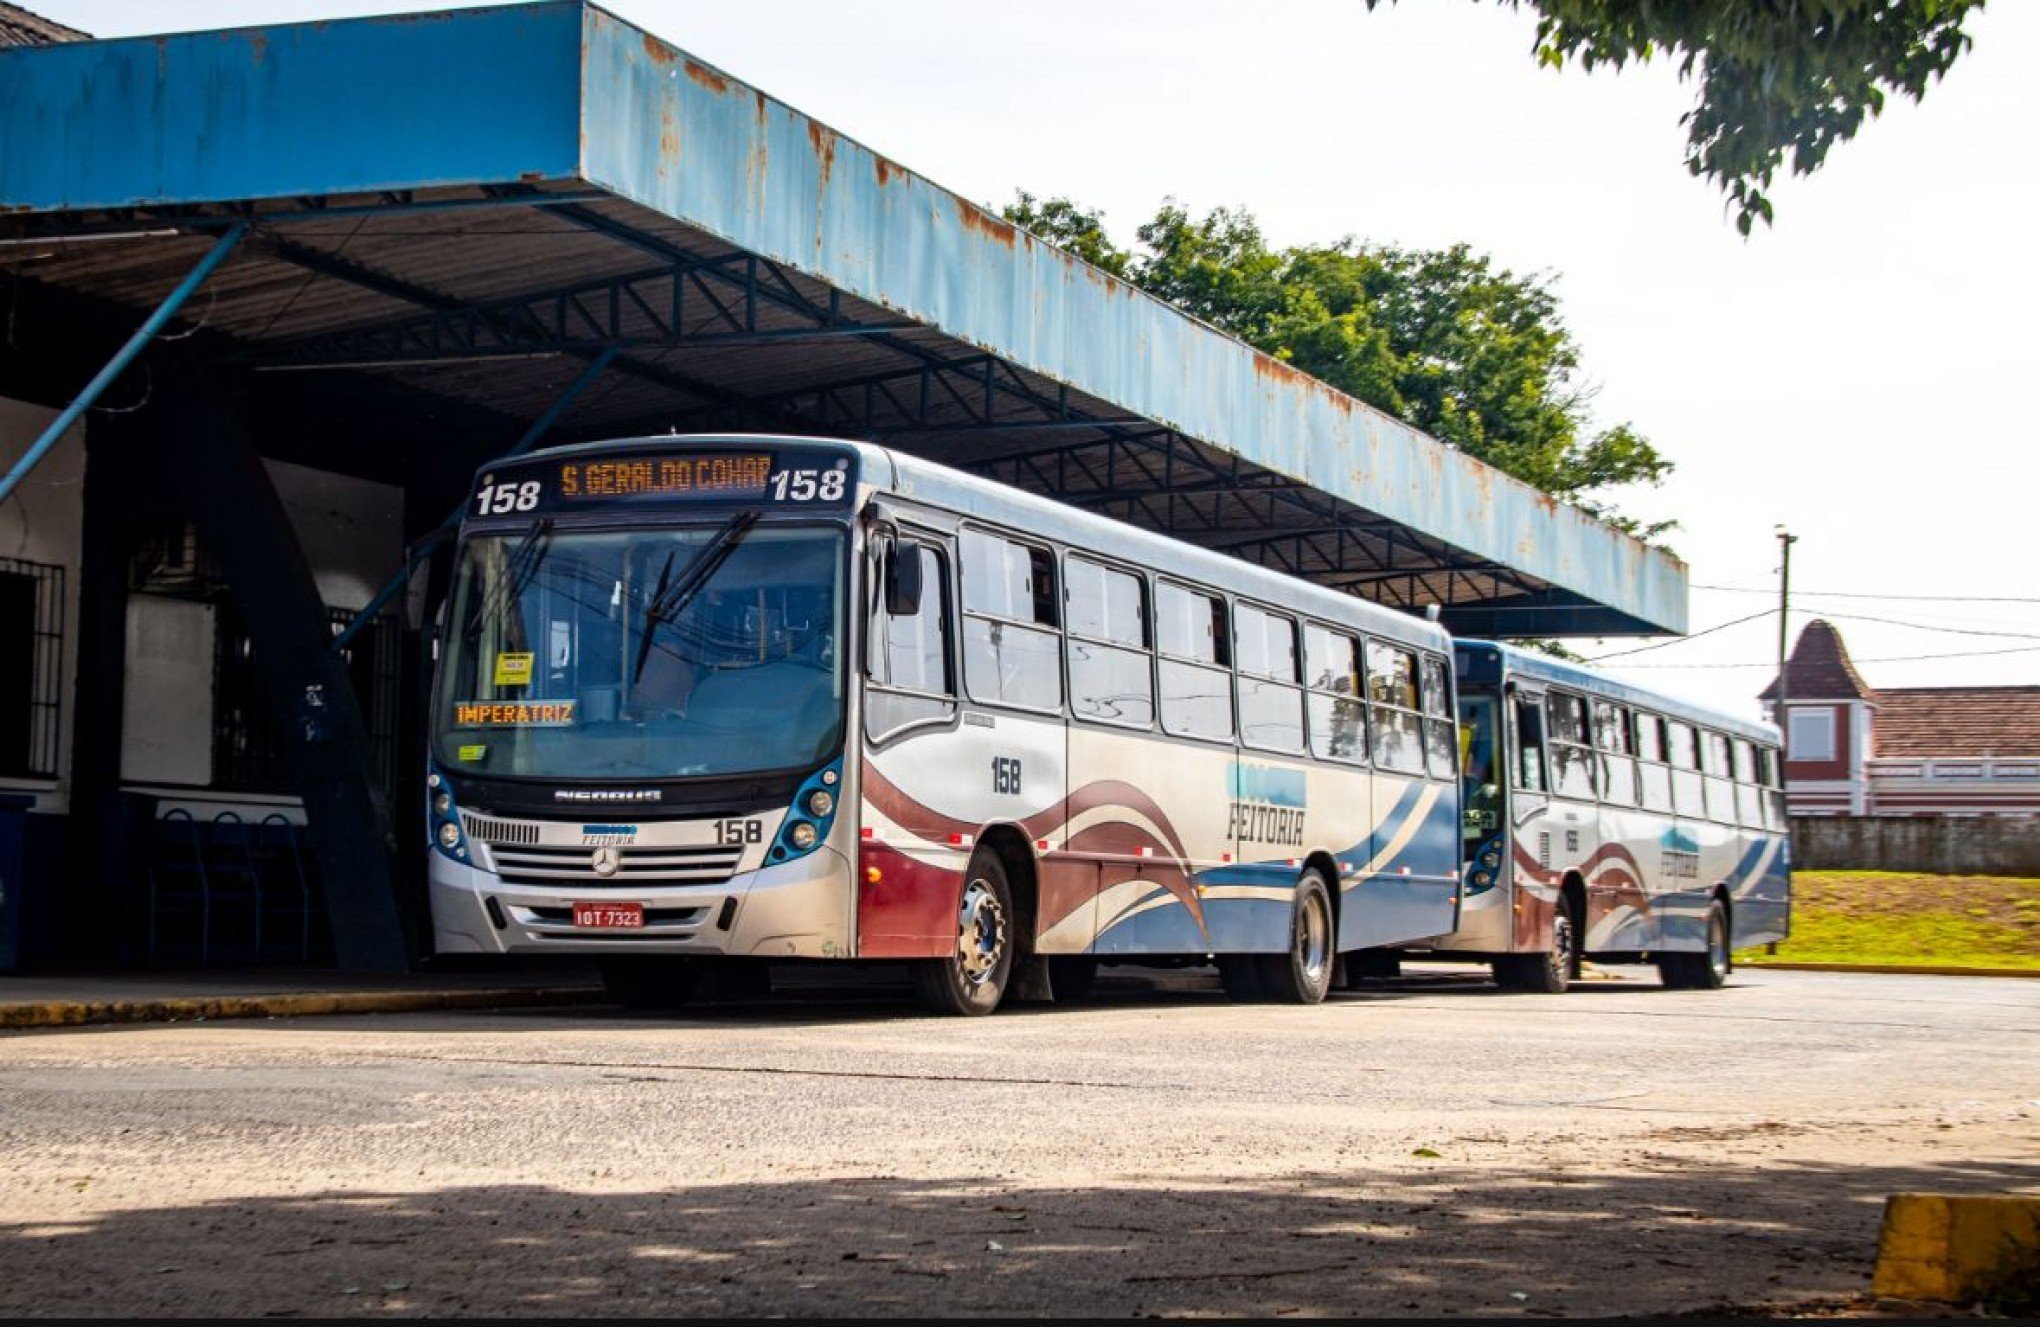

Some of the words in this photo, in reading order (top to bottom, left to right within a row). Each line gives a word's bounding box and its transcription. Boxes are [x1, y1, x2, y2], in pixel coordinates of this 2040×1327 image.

[477, 480, 541, 515] 158
[771, 469, 846, 501] 158
[458, 704, 572, 723] IMPERATRIZ
[991, 756, 1021, 794] 158
[713, 819, 762, 845] 158
[1227, 803, 1305, 846] FEITORIA
